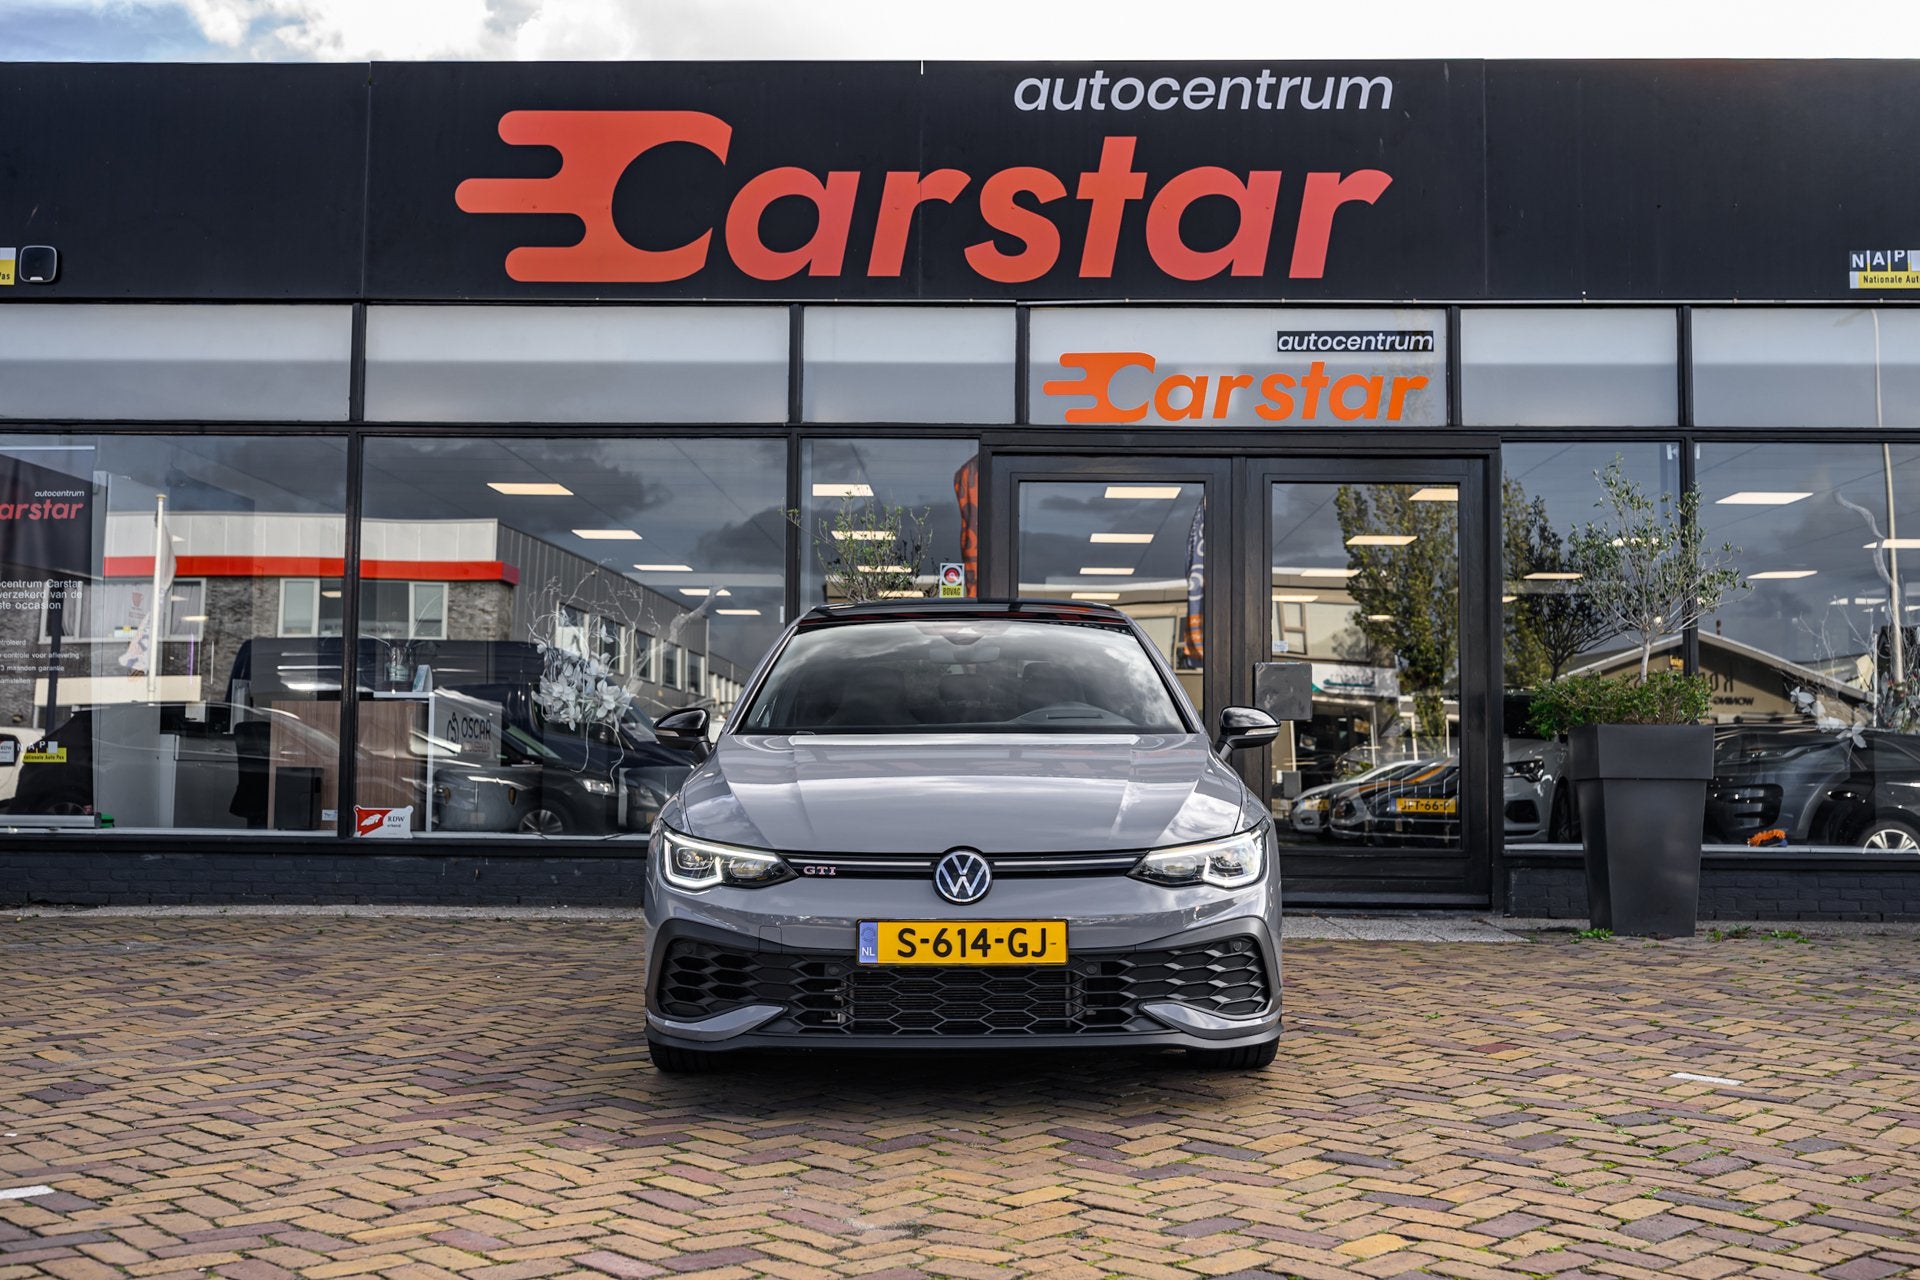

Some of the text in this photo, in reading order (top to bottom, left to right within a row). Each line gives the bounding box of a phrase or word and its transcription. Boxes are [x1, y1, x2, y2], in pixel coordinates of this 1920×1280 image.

[1013, 69, 1394, 112] autocentrum
[455, 110, 1393, 283] Carstar
[1852, 250, 1905, 268] NAP
[1863, 275, 1920, 283] Nationale Aut
[1278, 332, 1433, 351] autocentrum
[1043, 351, 1429, 423] Carstar
[0, 499, 84, 520] arstar
[0, 579, 81, 588] centrum Carstar
[50, 591, 67, 599] van
[71, 590, 82, 599] de
[15, 601, 61, 609] occasion
[387, 815, 406, 823] RDW
[803, 866, 837, 876] GTI
[861, 927, 1047, 958] NL S-614-GJ
